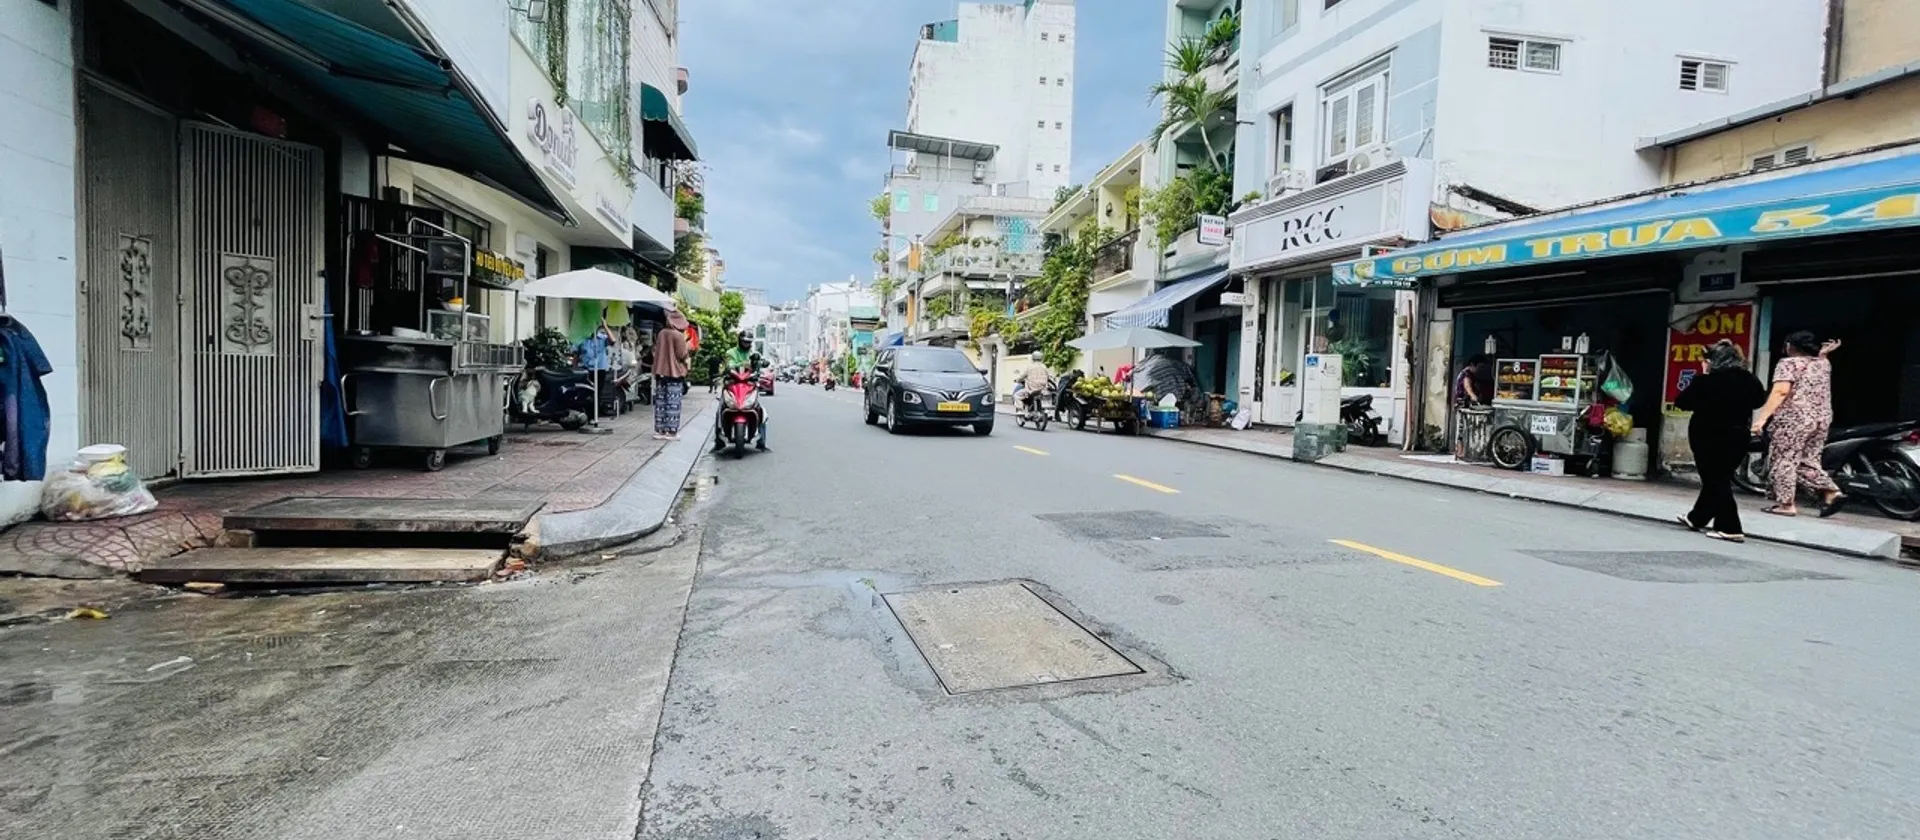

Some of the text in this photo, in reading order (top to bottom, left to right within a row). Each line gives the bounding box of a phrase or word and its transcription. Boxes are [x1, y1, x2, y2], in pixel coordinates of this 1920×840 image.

[1281, 205, 1344, 251] RCC
[1524, 217, 1722, 258] TRƯA
[1682, 310, 1746, 335] ƠM
